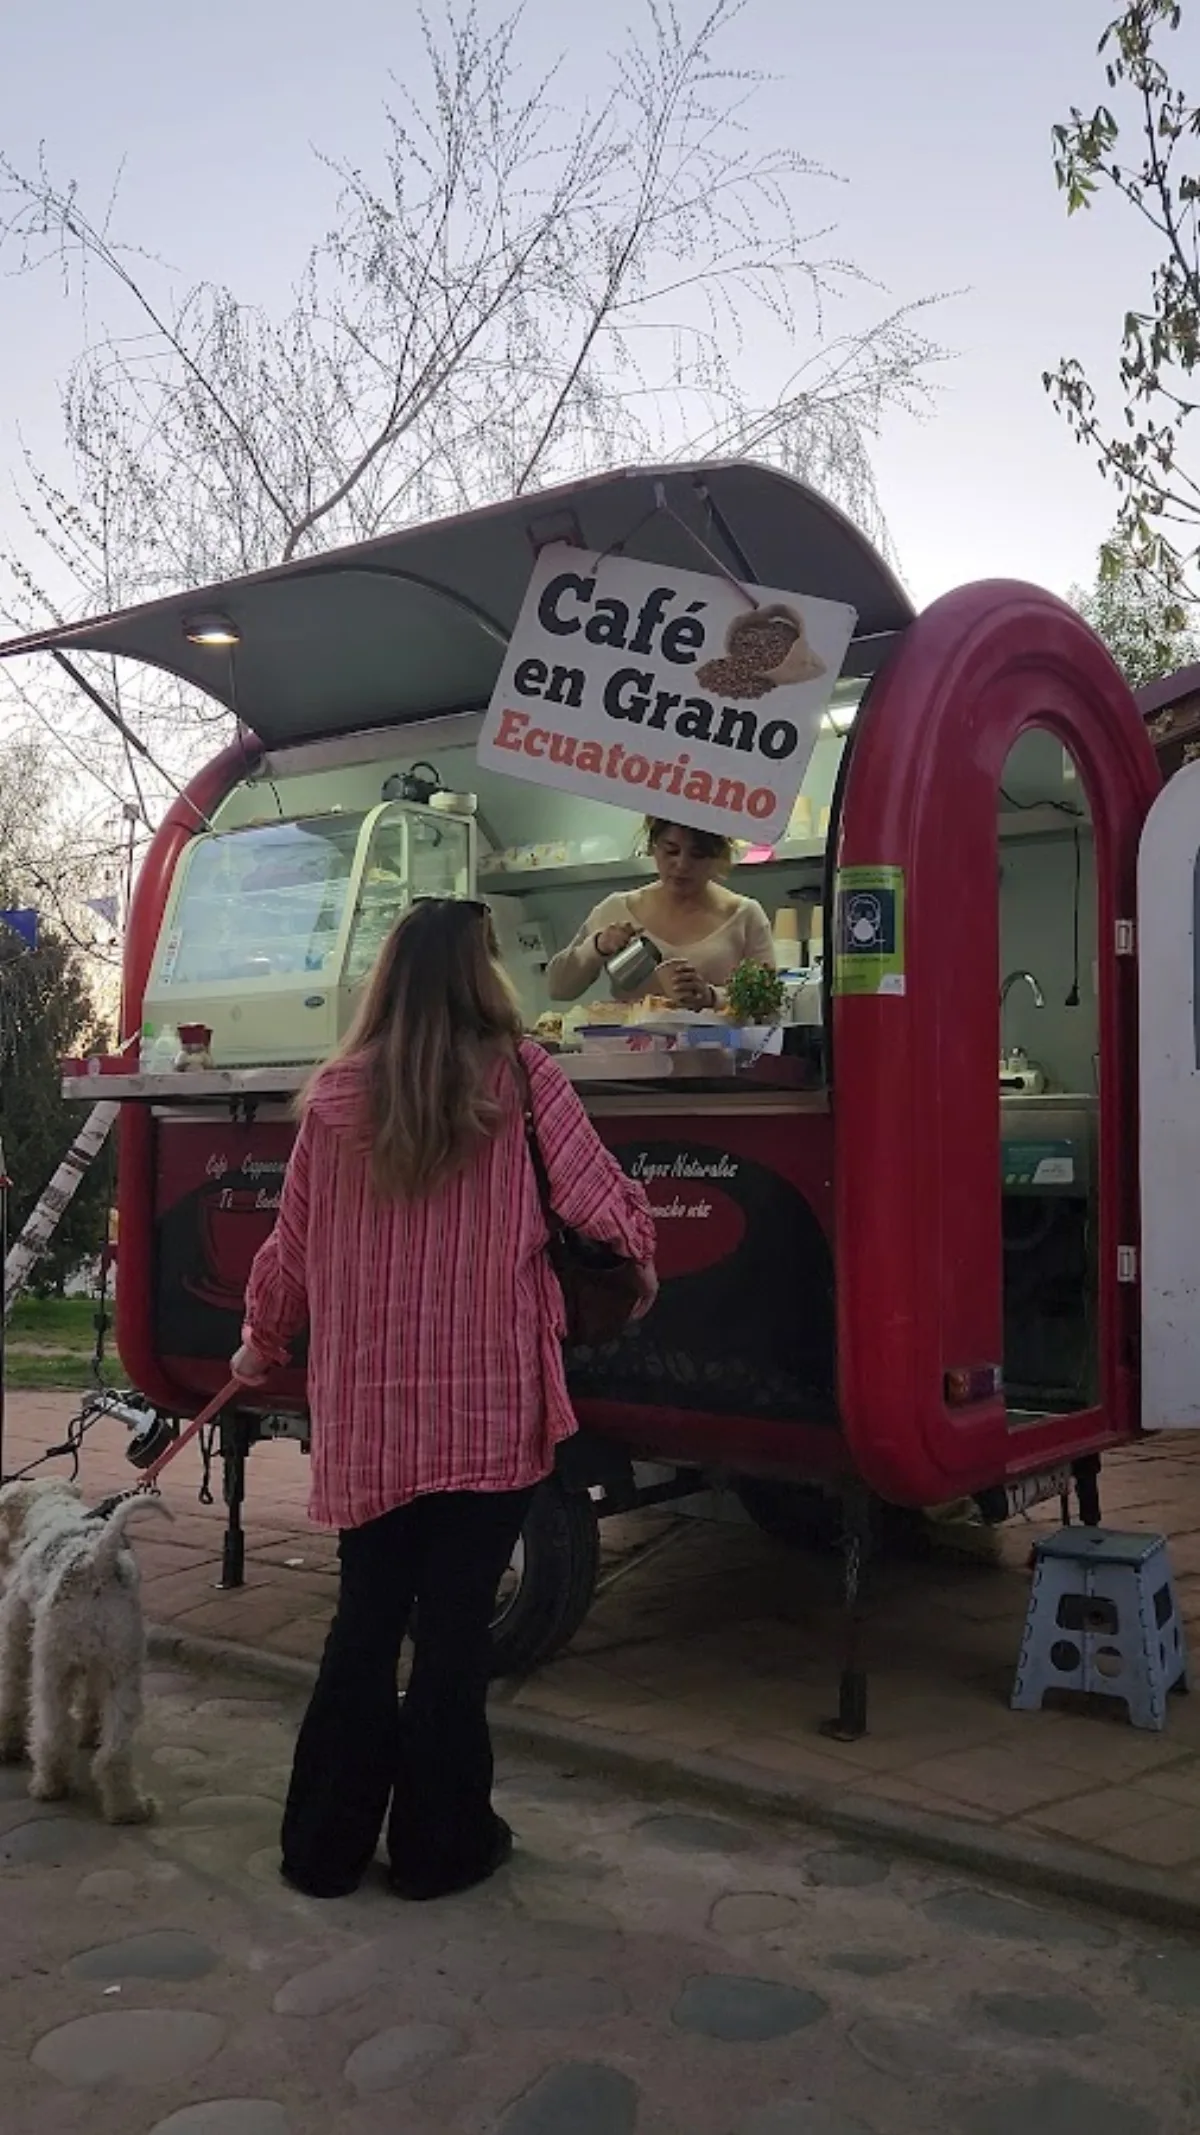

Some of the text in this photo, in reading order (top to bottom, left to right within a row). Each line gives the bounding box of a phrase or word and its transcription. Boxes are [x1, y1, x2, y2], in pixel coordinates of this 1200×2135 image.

[537, 572, 706, 665] Café
[513, 657, 799, 760] en Grano
[493, 708, 777, 820] Ecuatoriano
